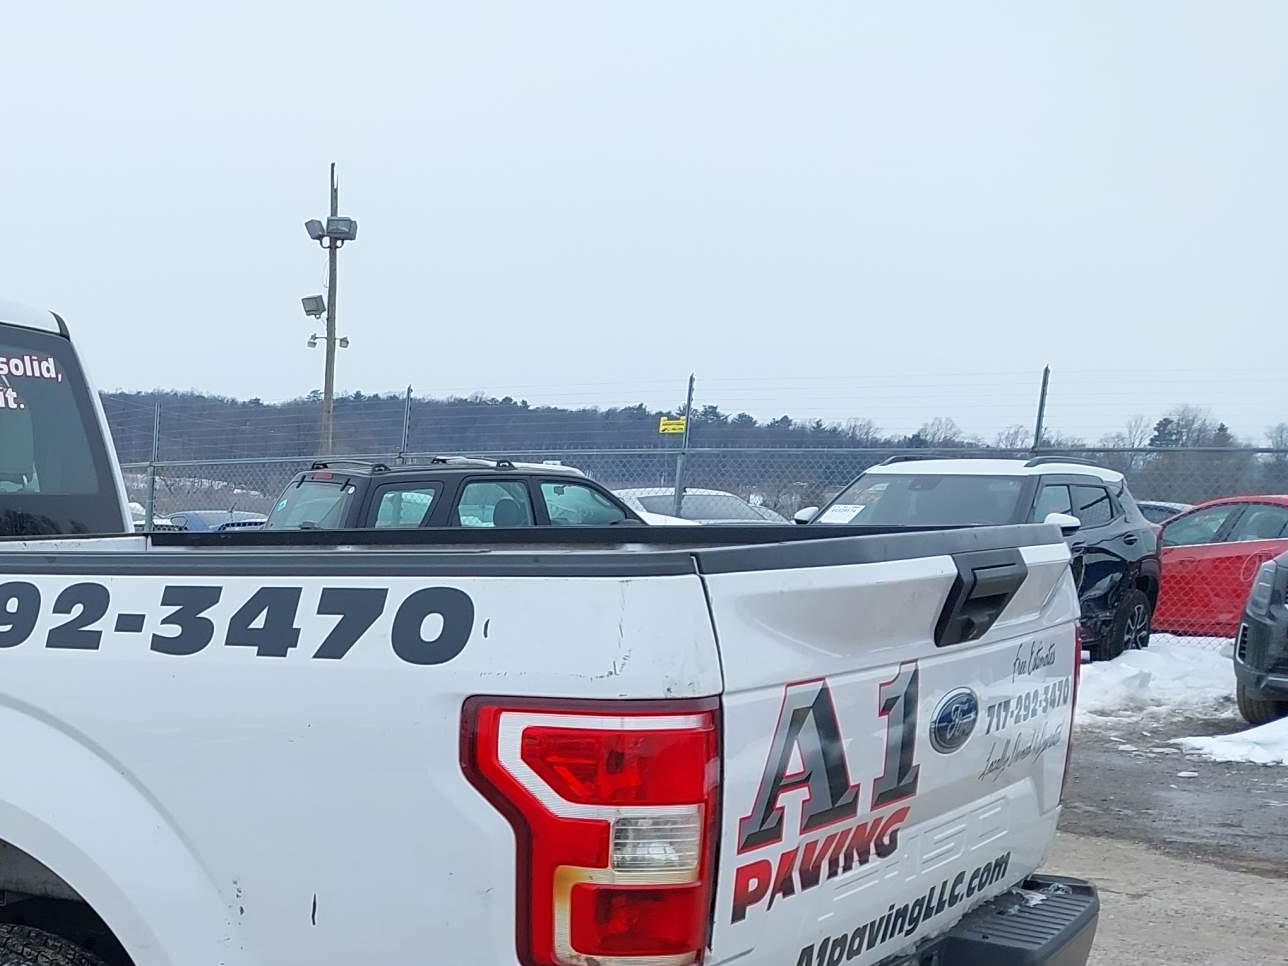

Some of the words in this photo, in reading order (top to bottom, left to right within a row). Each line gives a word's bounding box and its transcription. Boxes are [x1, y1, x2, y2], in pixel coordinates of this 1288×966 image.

[737, 659, 919, 856] A1
[985, 676, 1070, 735] 717-292-3470
[730, 805, 911, 926] PAVING
